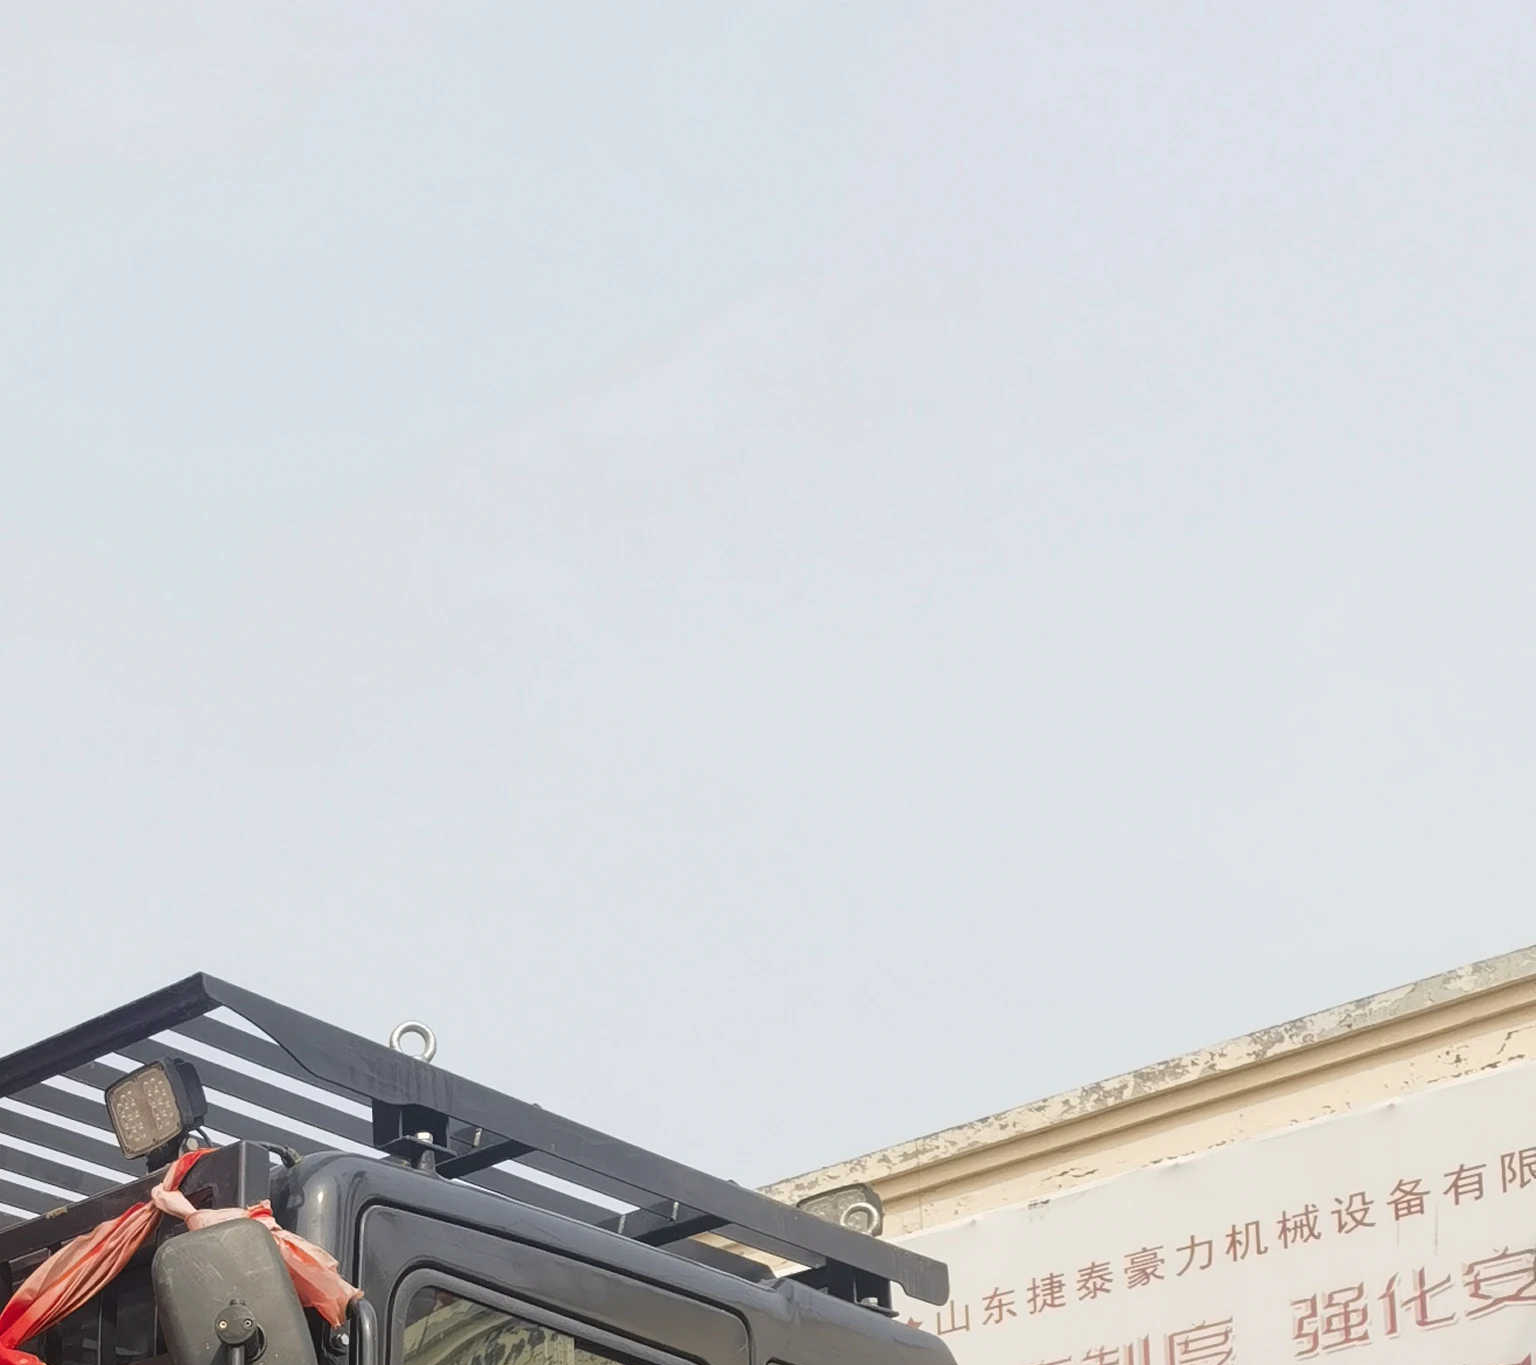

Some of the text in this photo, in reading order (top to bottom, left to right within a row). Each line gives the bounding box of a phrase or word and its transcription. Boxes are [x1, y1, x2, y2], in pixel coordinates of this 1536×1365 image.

[936, 1146, 1536, 1336] 山东捷泰豪力机械设备有限
